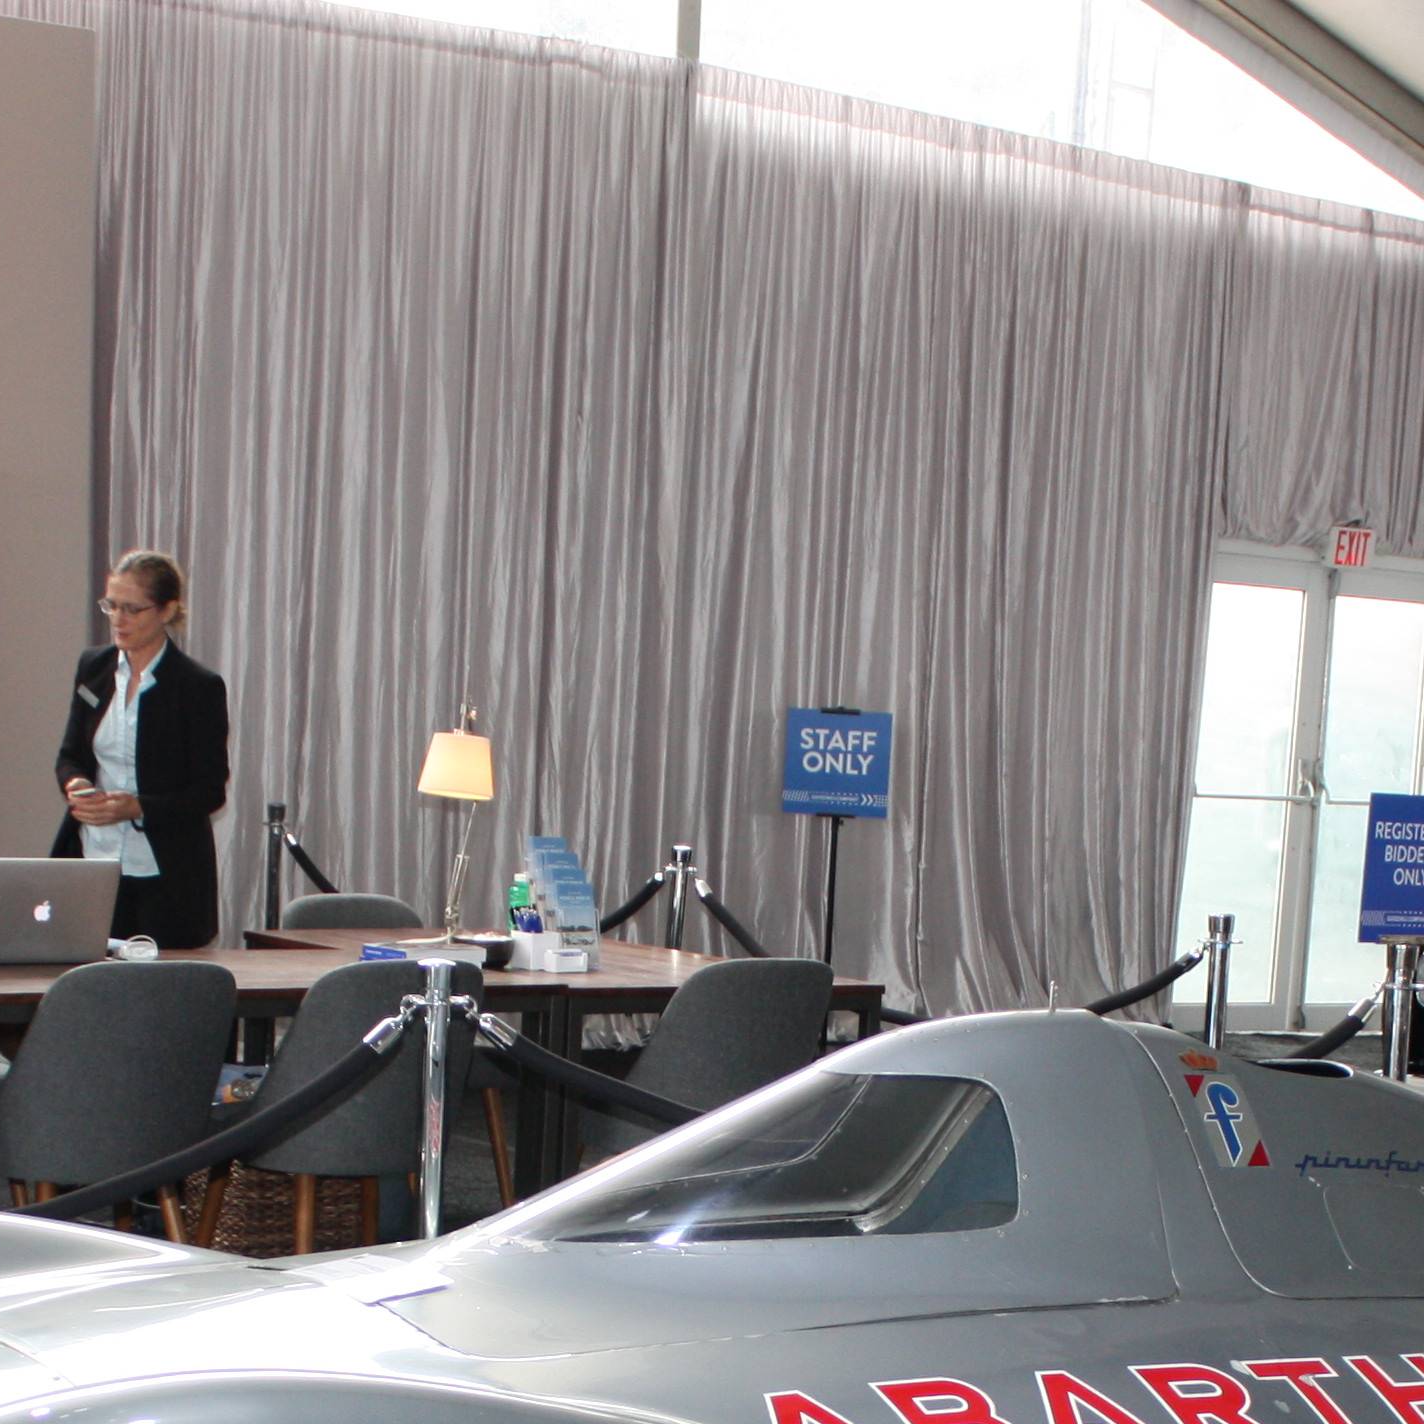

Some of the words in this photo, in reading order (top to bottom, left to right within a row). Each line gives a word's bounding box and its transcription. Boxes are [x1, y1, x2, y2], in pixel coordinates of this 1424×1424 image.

[1334, 530, 1372, 567] EXIT
[799, 727, 878, 753] STAFF
[801, 750, 875, 776] ONLY
